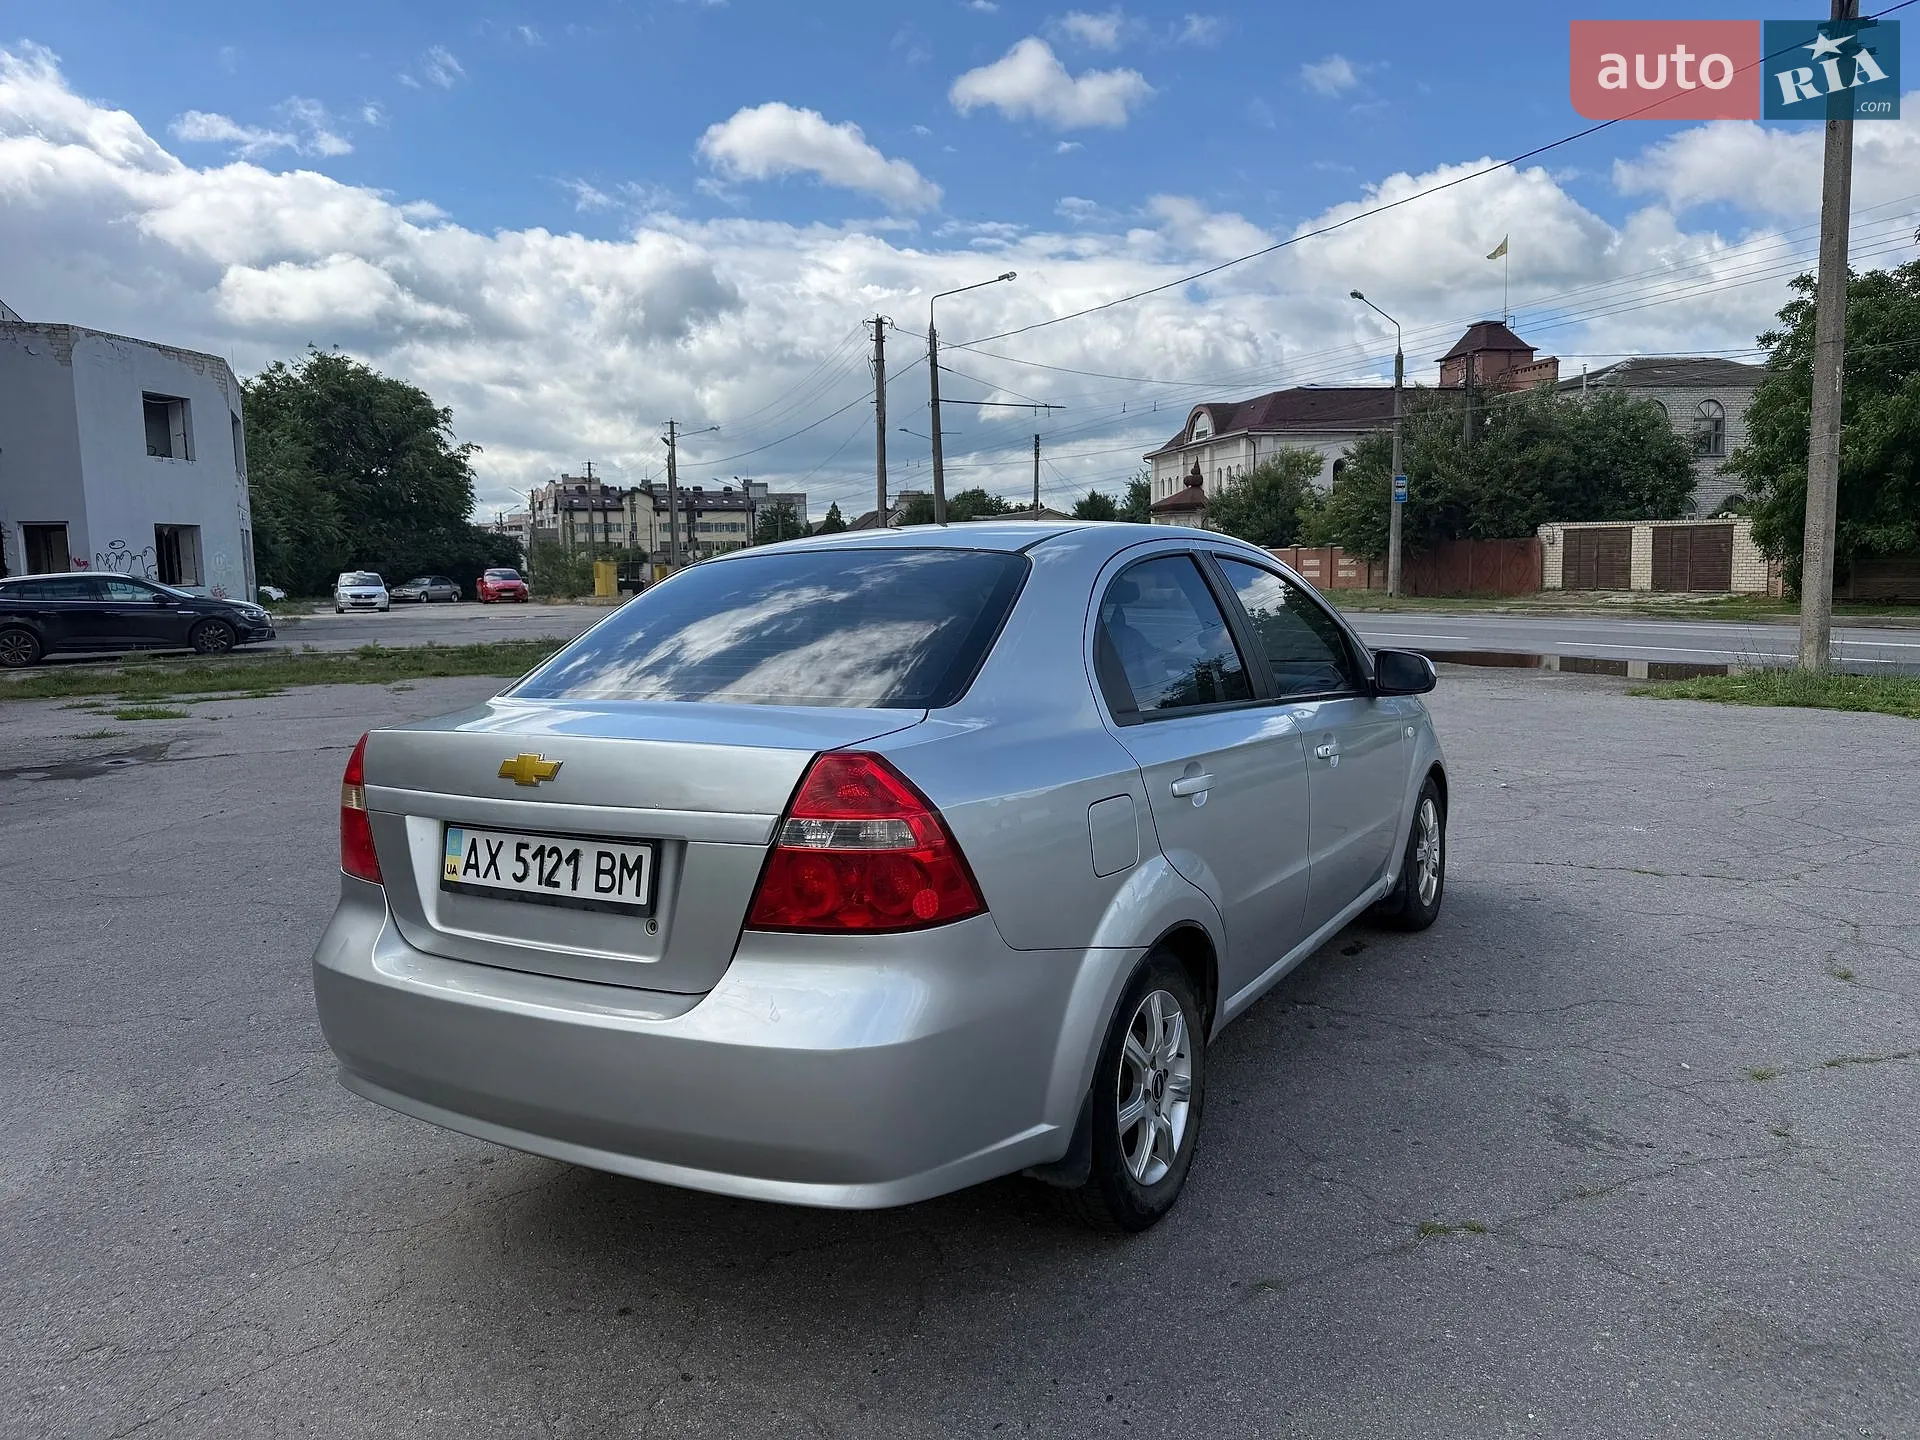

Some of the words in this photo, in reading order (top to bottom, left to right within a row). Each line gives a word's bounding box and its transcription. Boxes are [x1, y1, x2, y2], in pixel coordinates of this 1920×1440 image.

[446, 863, 458, 876] UA
[462, 837, 504, 881] AX
[511, 841, 582, 892] 5121
[594, 850, 644, 898] BM
